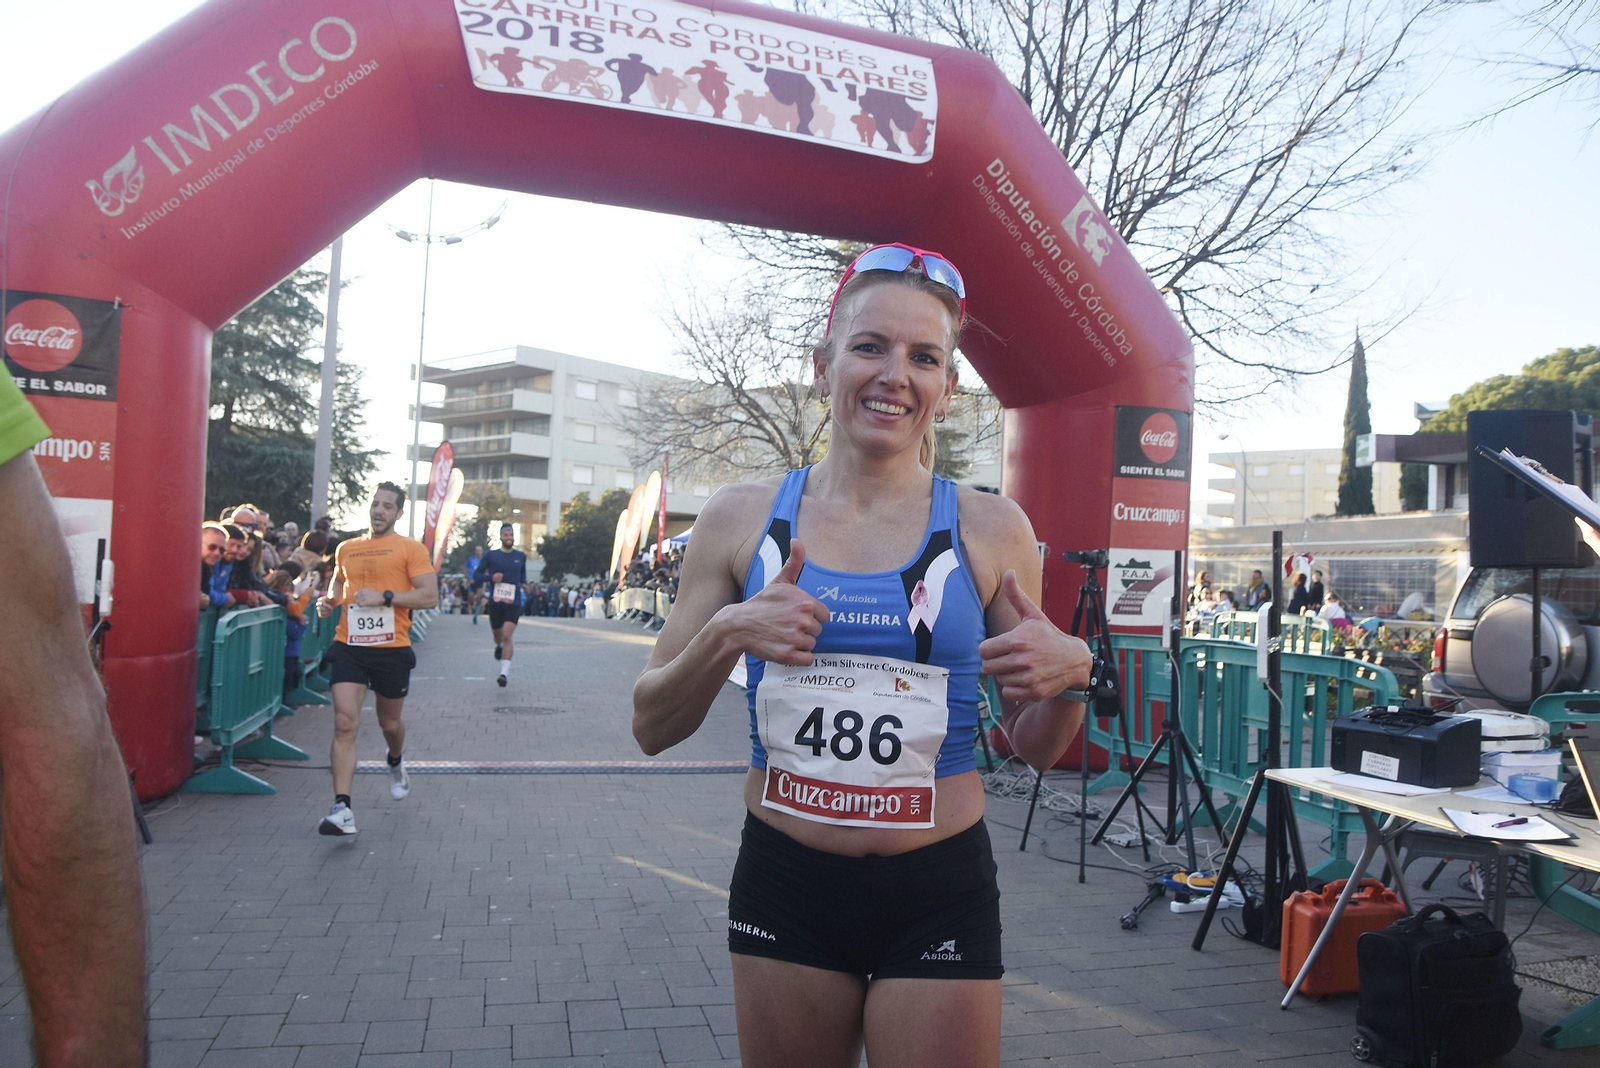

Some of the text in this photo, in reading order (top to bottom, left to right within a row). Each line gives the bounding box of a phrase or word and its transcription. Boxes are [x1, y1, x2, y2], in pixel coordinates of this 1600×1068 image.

[459, 10, 605, 54] 2018
[547, 0, 928, 80] UITO CORDOBÉS de
[460, 0, 928, 96] CARRERAS POPULARES
[142, 15, 358, 176] IMDECO
[120, 58, 380, 240] Instituto Municipal de Deportes Córdoba
[986, 157, 1133, 357] Diputación de Córdoba
[972, 174, 1118, 368] Delegación de Juventud y Deportes
[4, 322, 79, 350] Coca-Cola
[30, 378, 50, 390] EL
[53, 380, 107, 396] SABOR
[1140, 429, 1178, 448] Coca-Cola
[99, 441, 111, 461] SIN
[1120, 465, 1186, 478] SIENTE EL SABOR
[1113, 502, 1180, 526] Cruzcampo
[1122, 570, 1152, 578] F.A.A.
[839, 593, 878, 604] Asioka
[357, 616, 384, 630] 934
[829, 611, 901, 626] TASIERRA
[820, 658, 838, 668] San
[840, 658, 880, 671] Silvestre
[881, 662, 929, 680] Cordobesa
[800, 674, 855, 689] IMDECO
[794, 706, 903, 765] 486
[777, 771, 901, 818] Cruzcampo
[910, 794, 920, 815] SIN
[920, 951, 962, 961] Asioka
